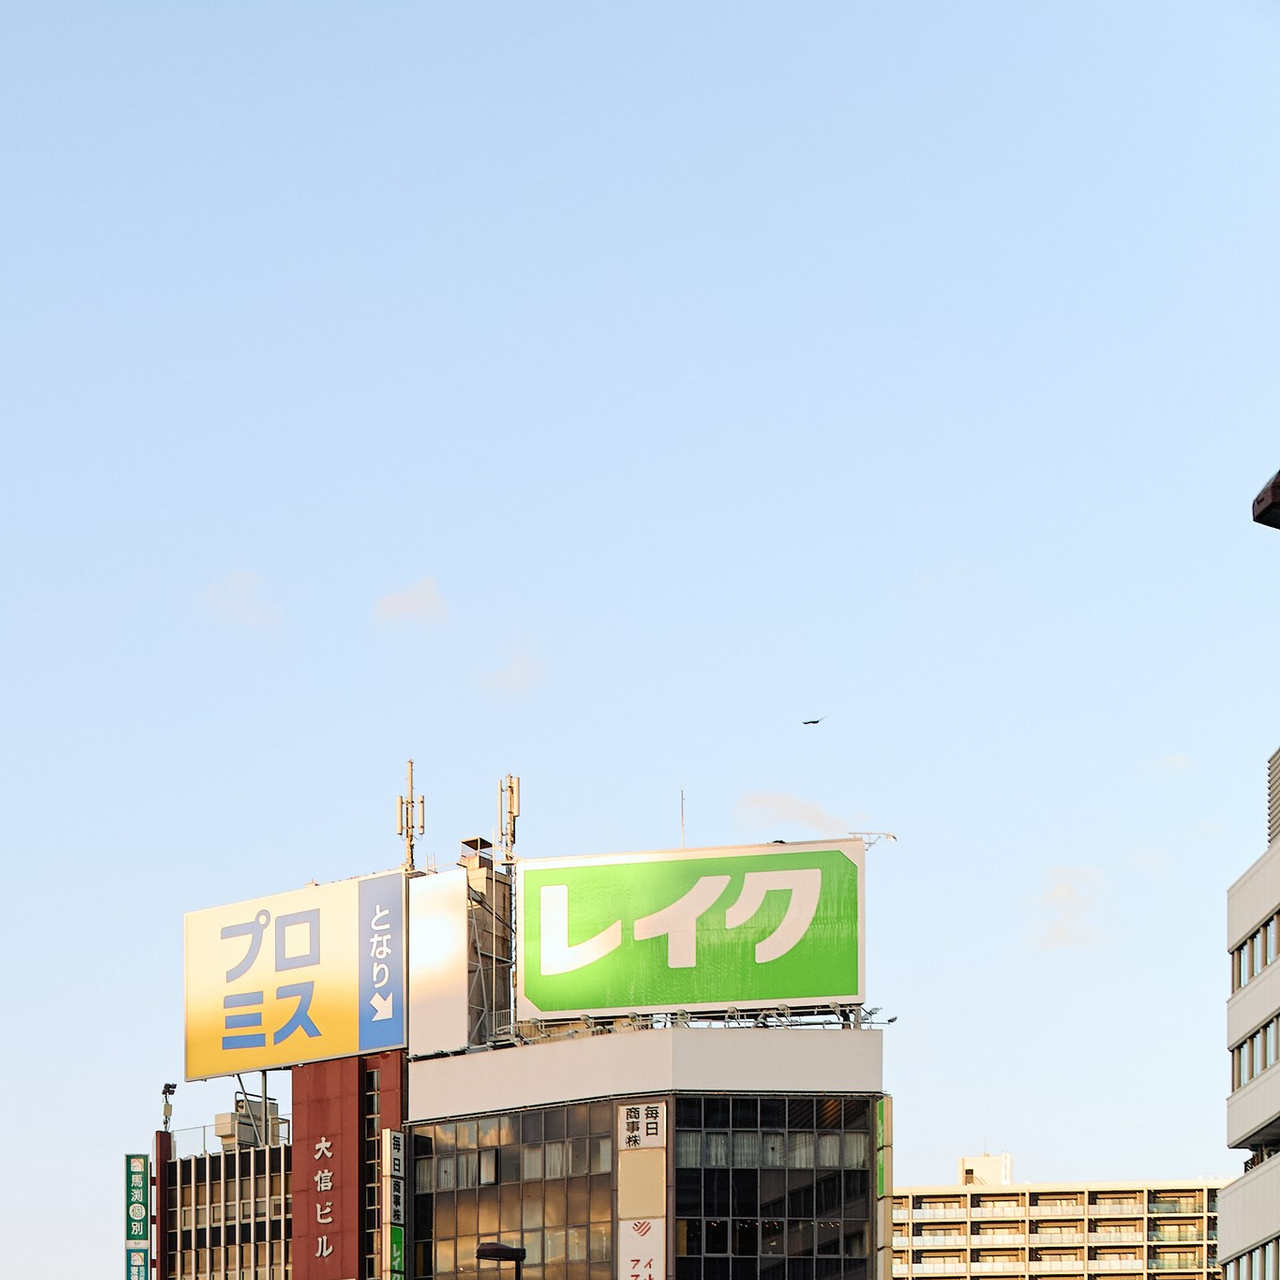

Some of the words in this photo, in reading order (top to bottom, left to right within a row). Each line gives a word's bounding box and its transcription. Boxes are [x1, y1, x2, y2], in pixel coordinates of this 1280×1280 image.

[220, 908, 321, 984] プロ
[368, 903, 391, 990] となり
[538, 866, 823, 978] レイク
[221, 979, 322, 1051] ミス
[313, 1136, 334, 1259] 大信ビル
